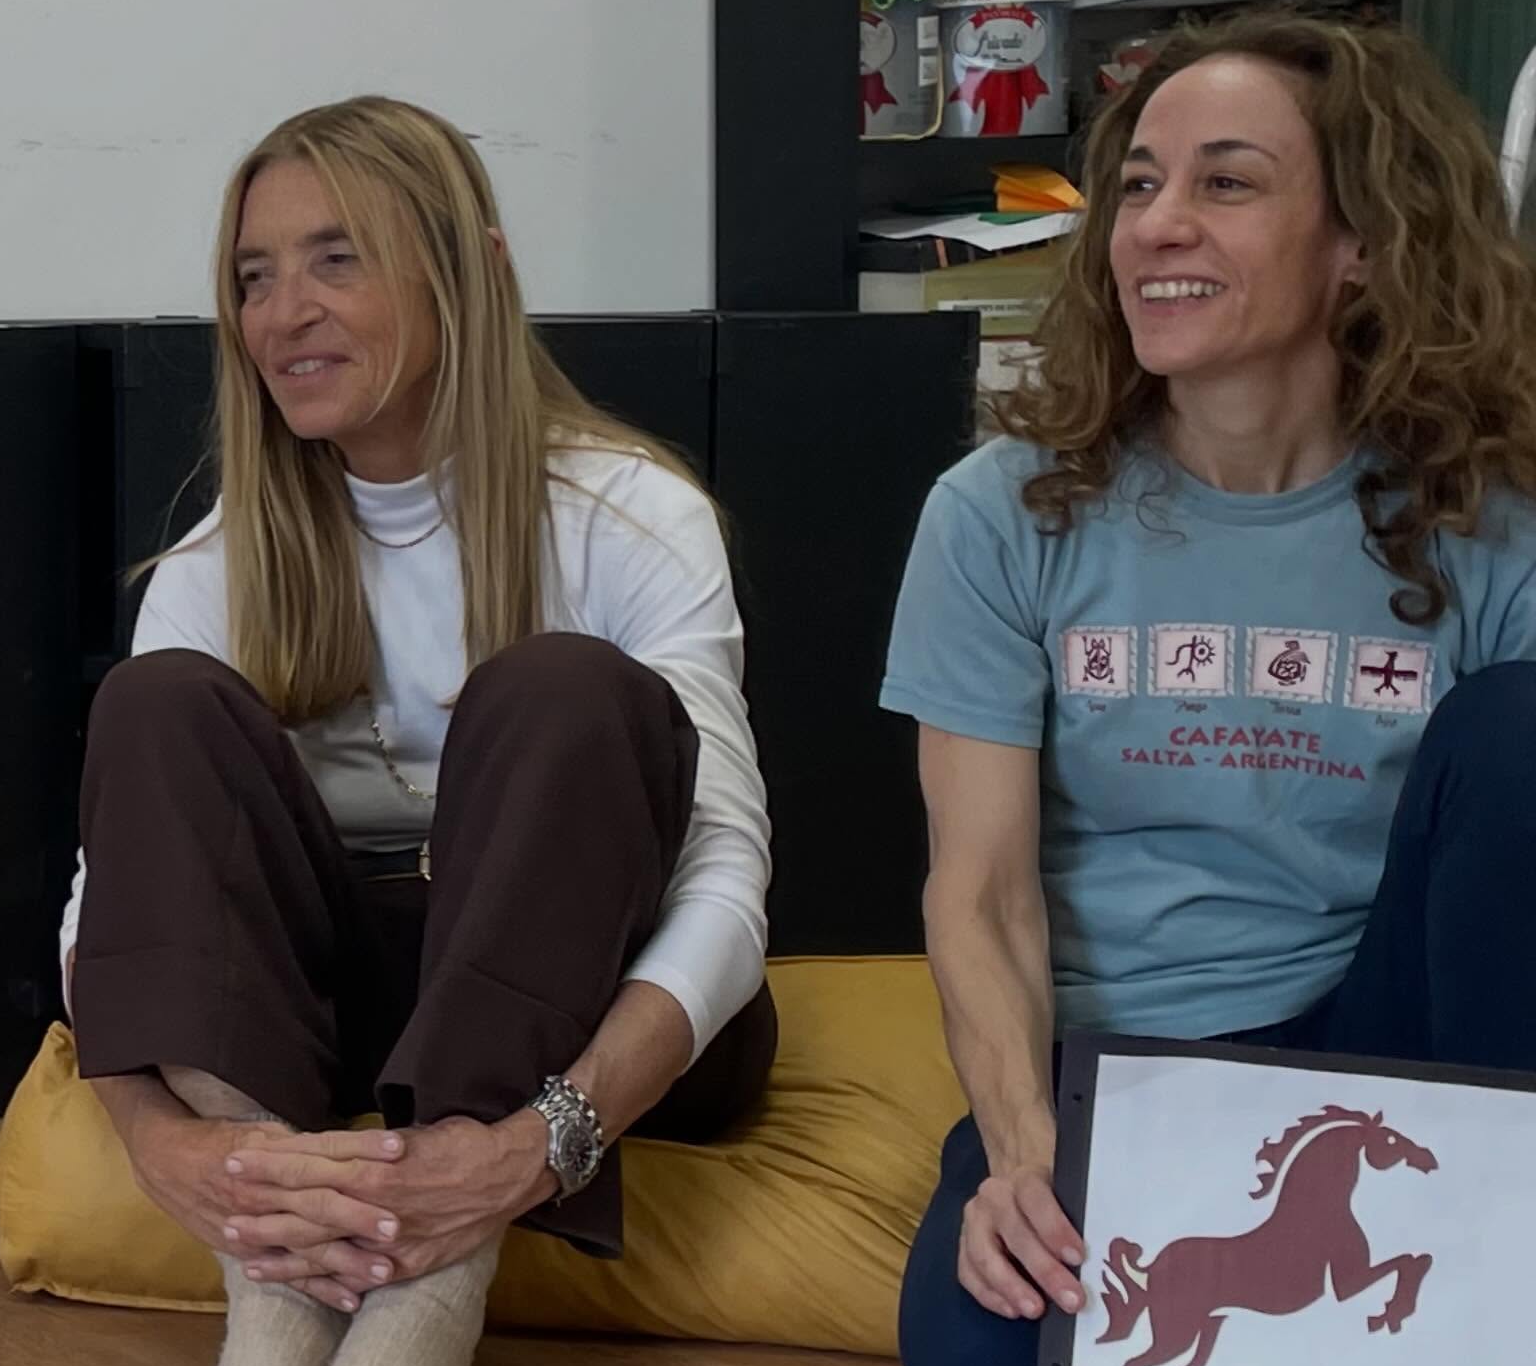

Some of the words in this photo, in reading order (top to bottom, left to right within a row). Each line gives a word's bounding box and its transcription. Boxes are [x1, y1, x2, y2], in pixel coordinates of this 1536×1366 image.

[1168, 725, 1322, 755] CAFAYATE
[1120, 746, 1198, 768] SALTA
[1219, 750, 1368, 783] ARGENTINA
